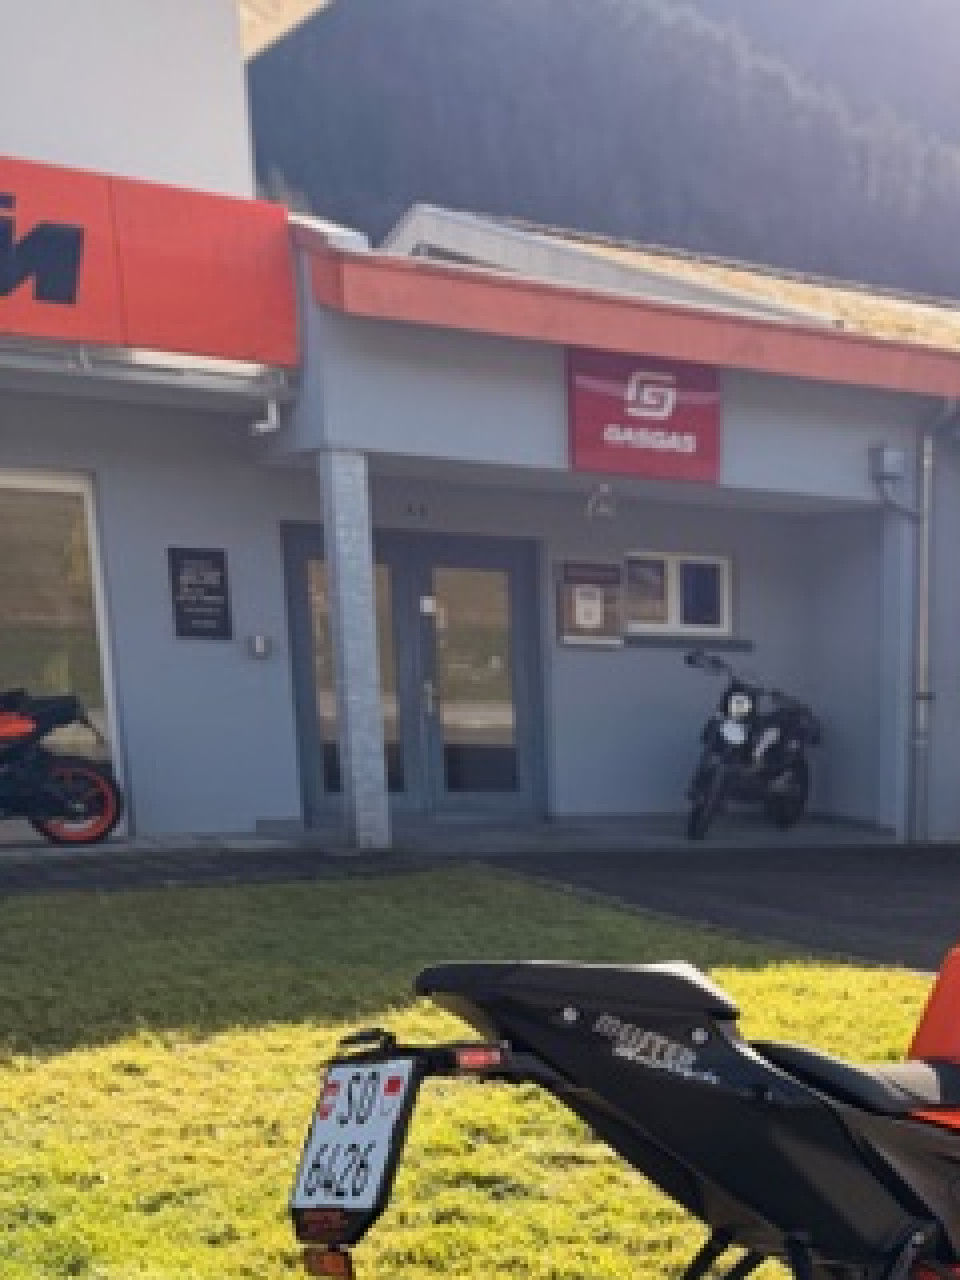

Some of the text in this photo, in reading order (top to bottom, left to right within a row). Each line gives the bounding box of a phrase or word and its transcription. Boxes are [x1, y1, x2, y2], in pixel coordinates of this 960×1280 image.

[603, 423, 697, 454] GASGAS
[337, 1071, 380, 1127] SO
[303, 1141, 378, 1197] 6426
